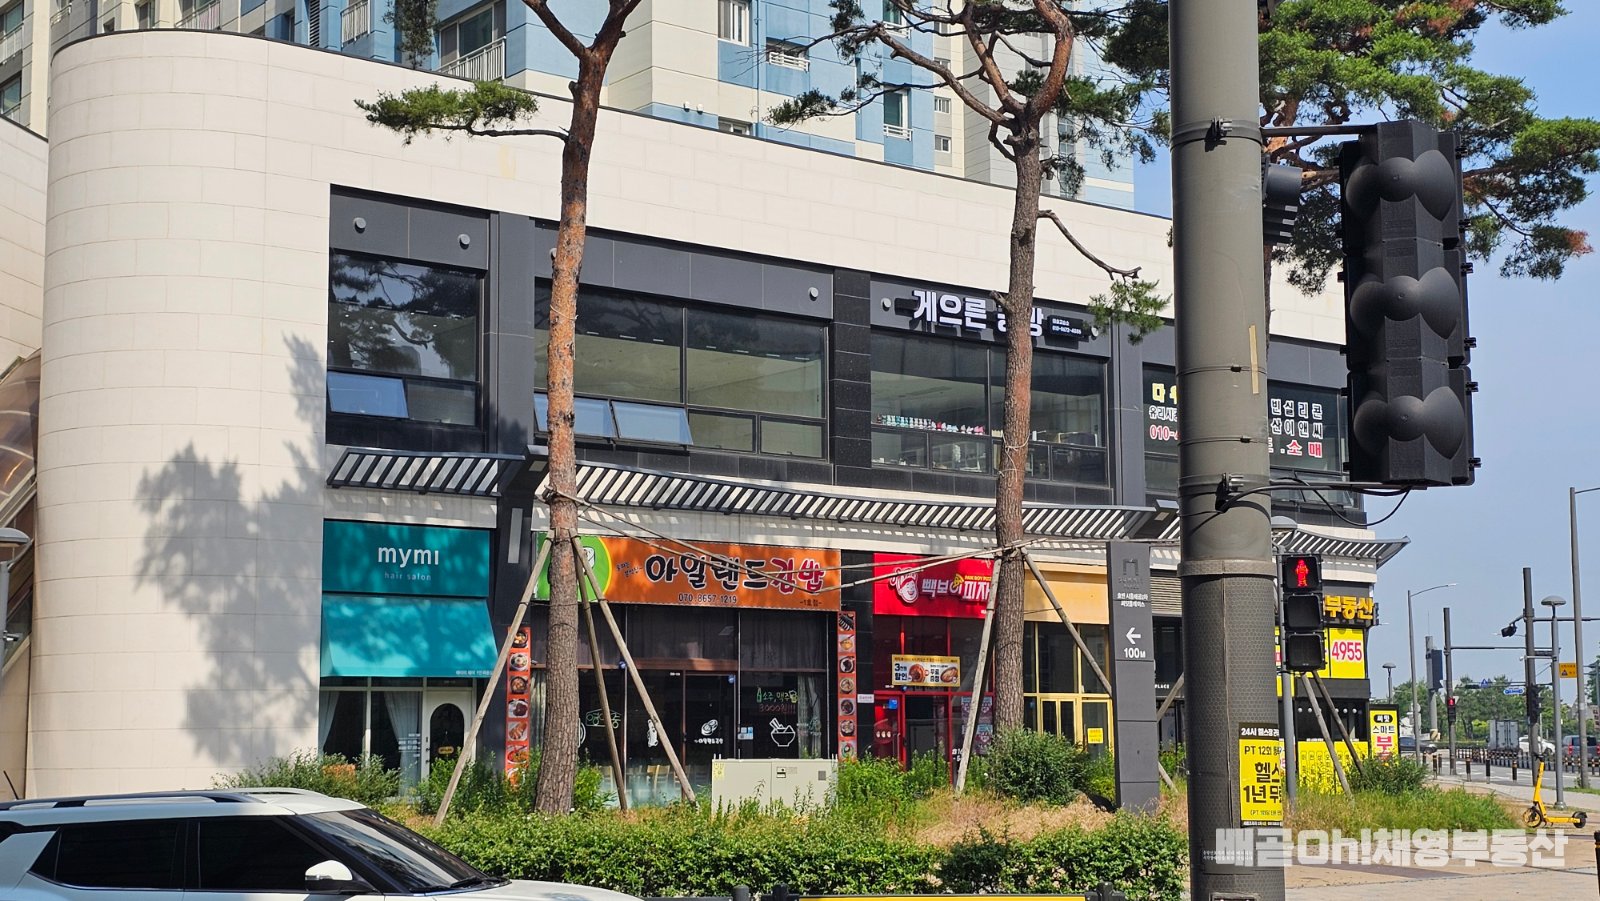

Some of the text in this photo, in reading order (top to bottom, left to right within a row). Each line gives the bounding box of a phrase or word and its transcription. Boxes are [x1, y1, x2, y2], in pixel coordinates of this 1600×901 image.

[913, 290, 1043, 337] 게으른 방
[377, 546, 440, 568] mymi
[384, 571, 432, 581] hair salon
[1323, 595, 1375, 621] 부동산
[1331, 641, 1363, 663] 4955
[1241, 728, 1257, 736] 24시
[1372, 725, 1396, 734] 스마트
[1244, 745, 1256, 755] PT
[1243, 785, 1282, 804] 1년 무
